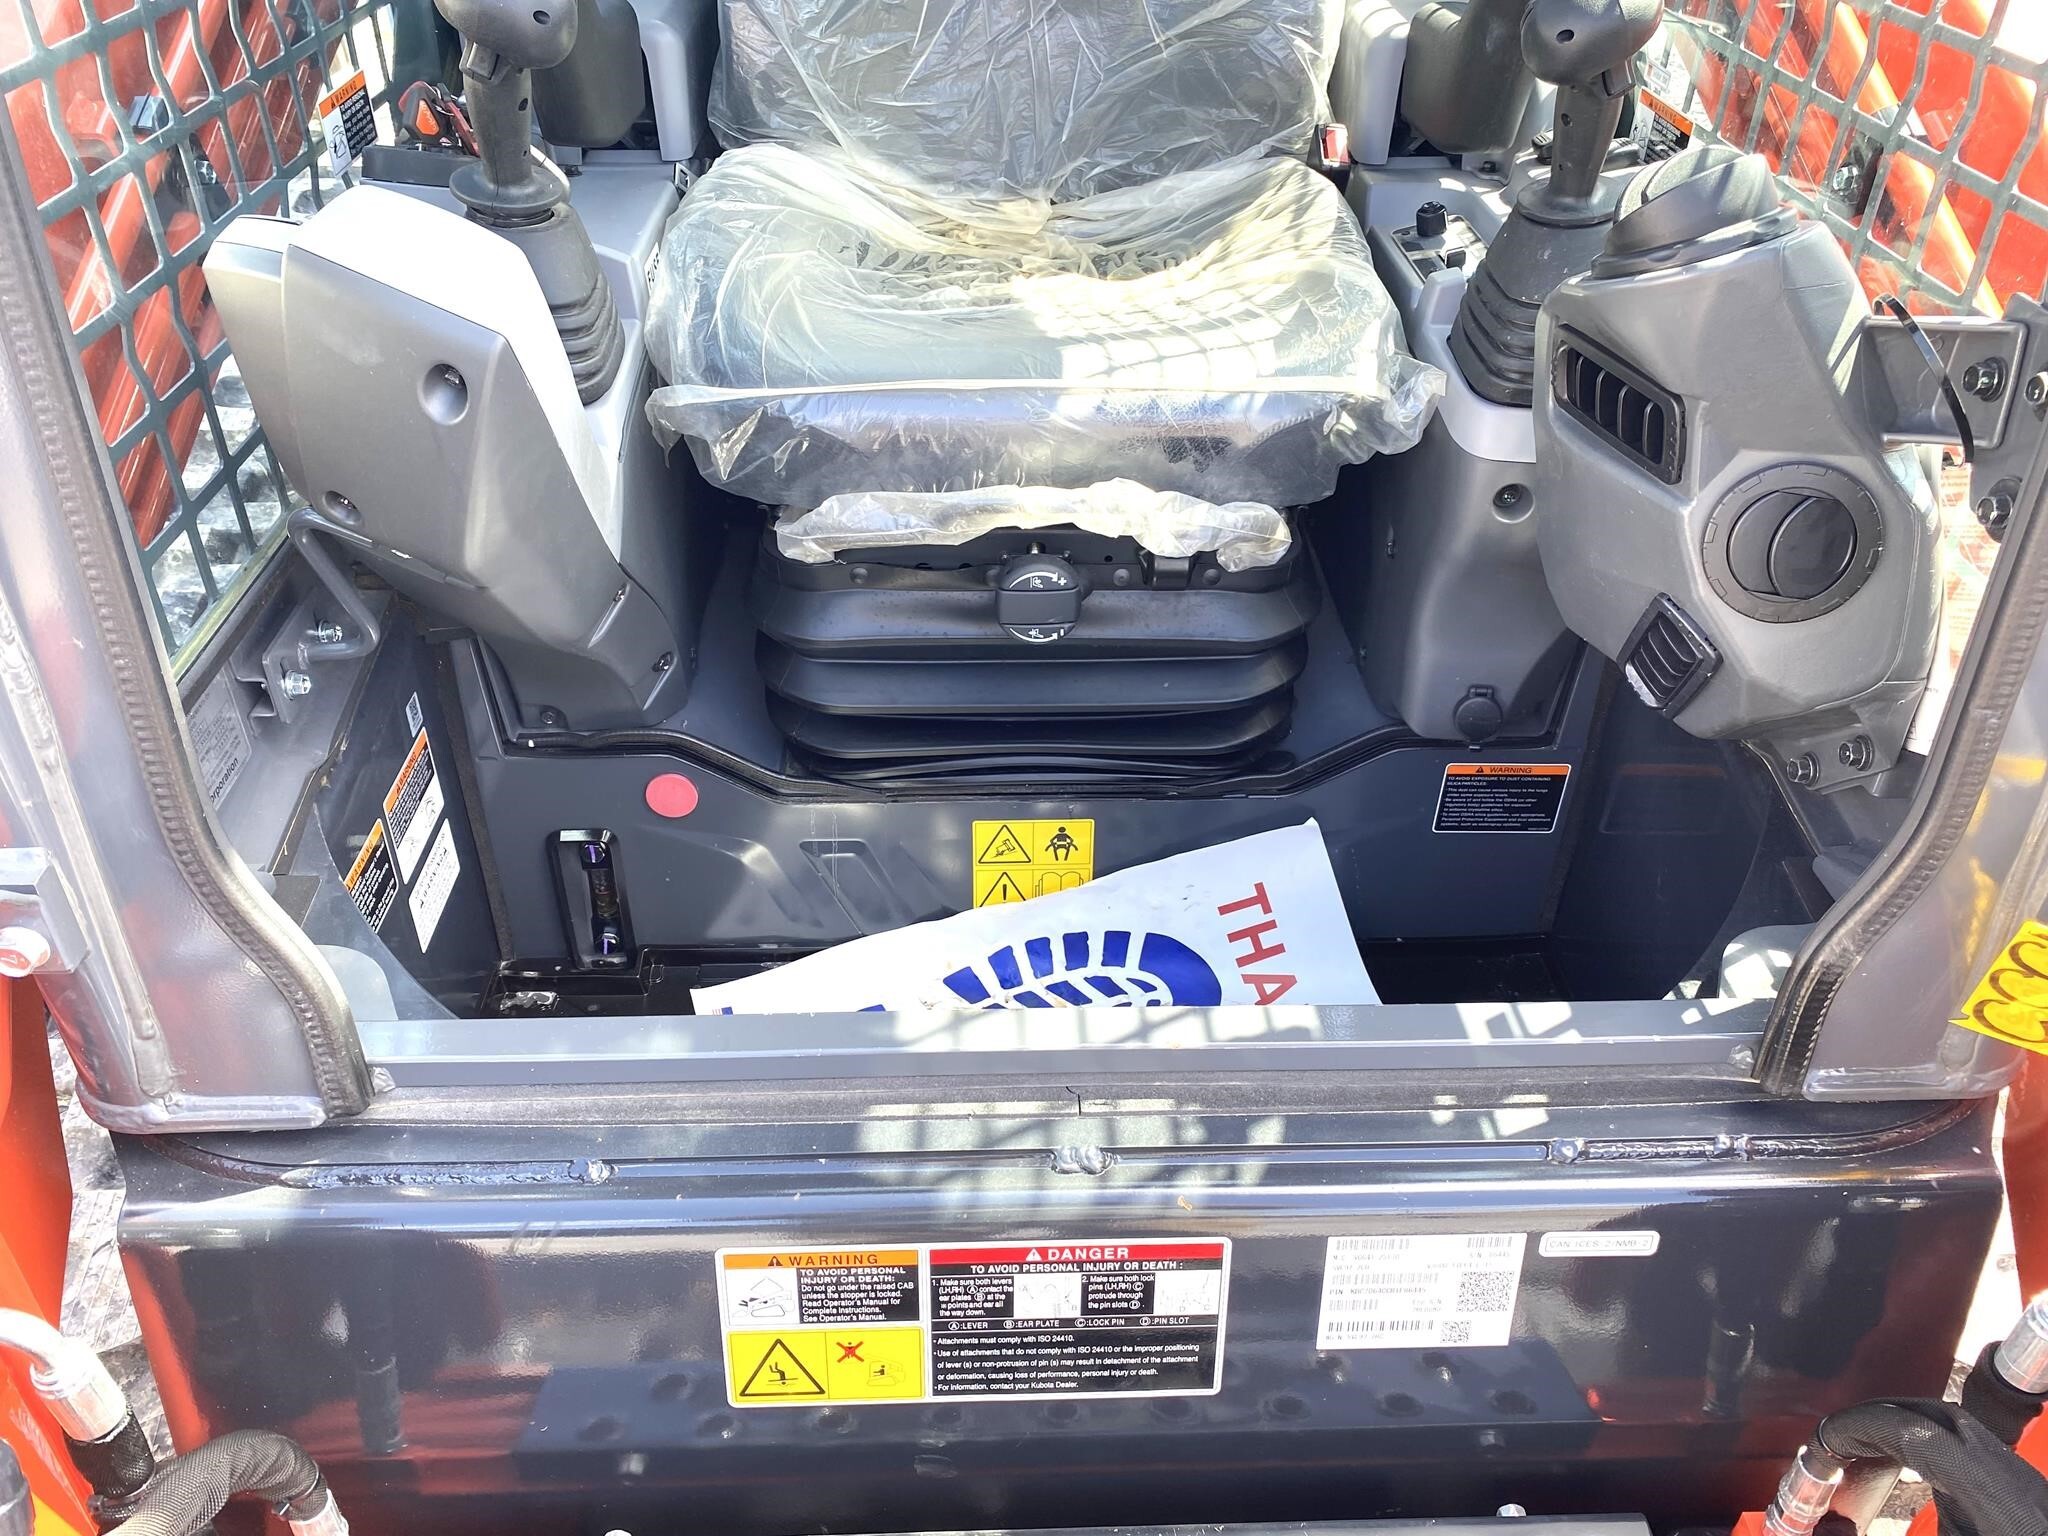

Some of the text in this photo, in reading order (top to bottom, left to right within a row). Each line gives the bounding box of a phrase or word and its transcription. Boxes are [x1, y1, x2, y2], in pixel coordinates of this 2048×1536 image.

[1549, 1240, 1570, 1248] CAN
[1048, 1248, 1129, 1260] DANGER
[788, 1254, 878, 1266] WARNING
[988, 1265, 1019, 1273] AVOID
[1022, 1264, 1079, 1272] PERSONAL
[1083, 1262, 1120, 1271] INJURY
[1124, 1262, 1139, 1270] OR
[840, 1292, 867, 1300] stopper
[823, 1299, 860, 1307] Operator's
[803, 1306, 837, 1315] Complete
[1165, 1344, 1199, 1352] positioning
[982, 1360, 1029, 1368] non-protrusion
